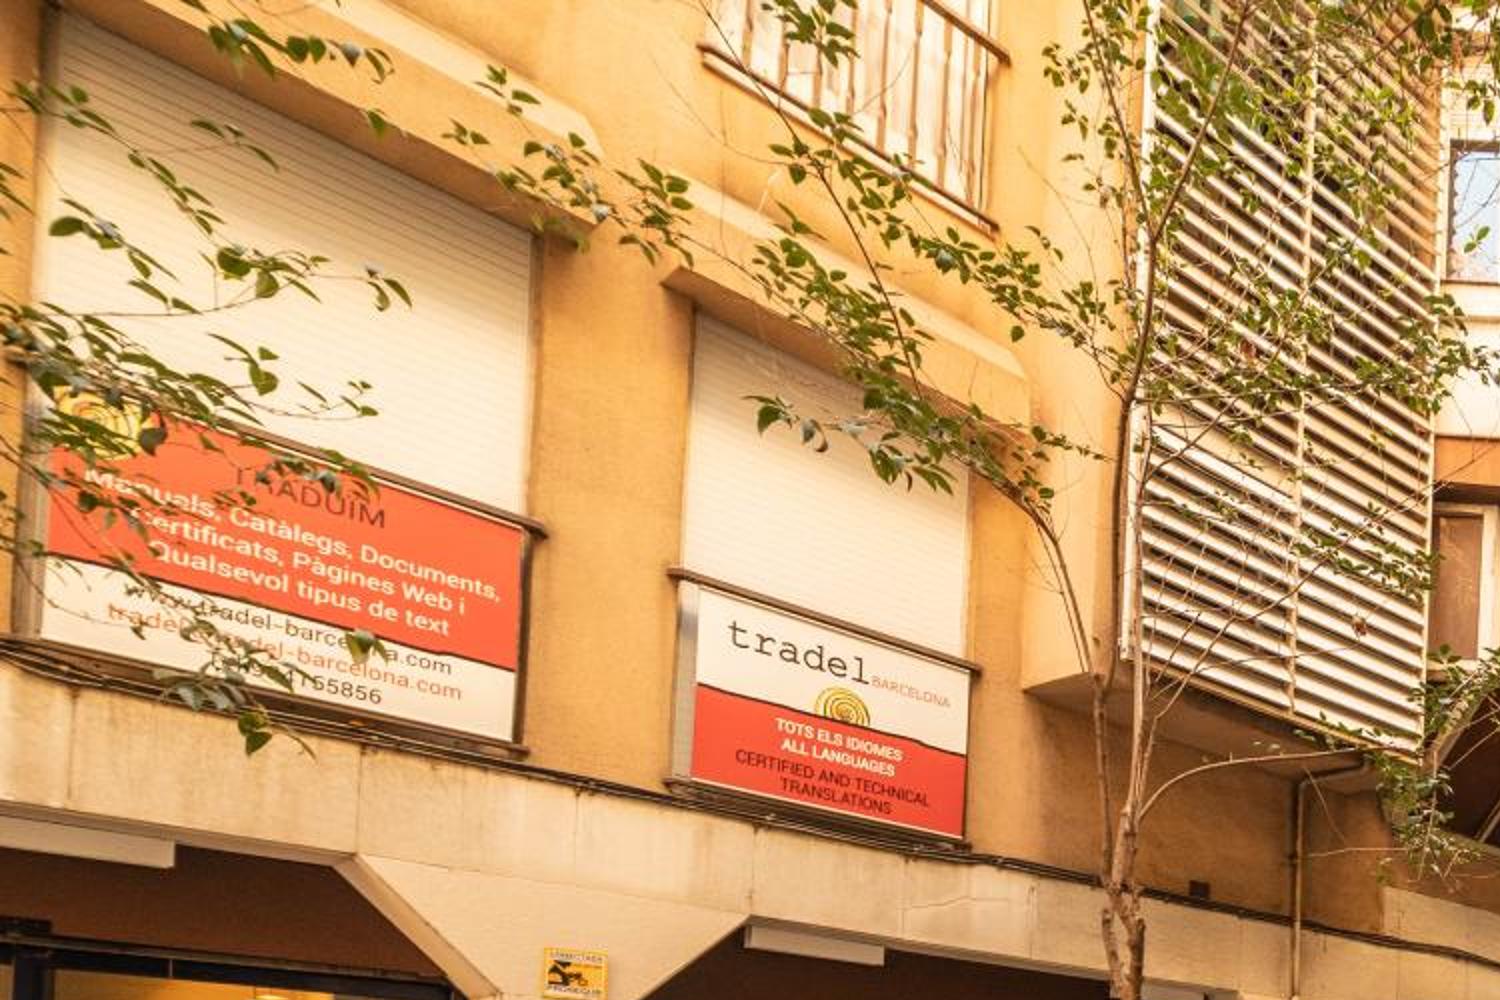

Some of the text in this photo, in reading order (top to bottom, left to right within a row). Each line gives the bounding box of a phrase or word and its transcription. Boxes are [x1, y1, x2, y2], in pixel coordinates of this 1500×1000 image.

[230, 506, 352, 560] Catàlegs,
[360, 543, 500, 603] Documents,
[293, 551, 395, 595] Pàgines
[401, 582, 453, 612] Web
[459, 598, 465, 615] i
[149, 540, 449, 636] Qualsevol tipus de text
[728, 620, 951, 708] tradel BARCELONA
[776, 717, 903, 762] TOTS ELS IDIOMES
[781, 738, 896, 776] ALL LANGUAGES
[735, 749, 929, 807] CERTIFIED AND TECHNICAL
[781, 777, 893, 815] TRANSLATIONS
